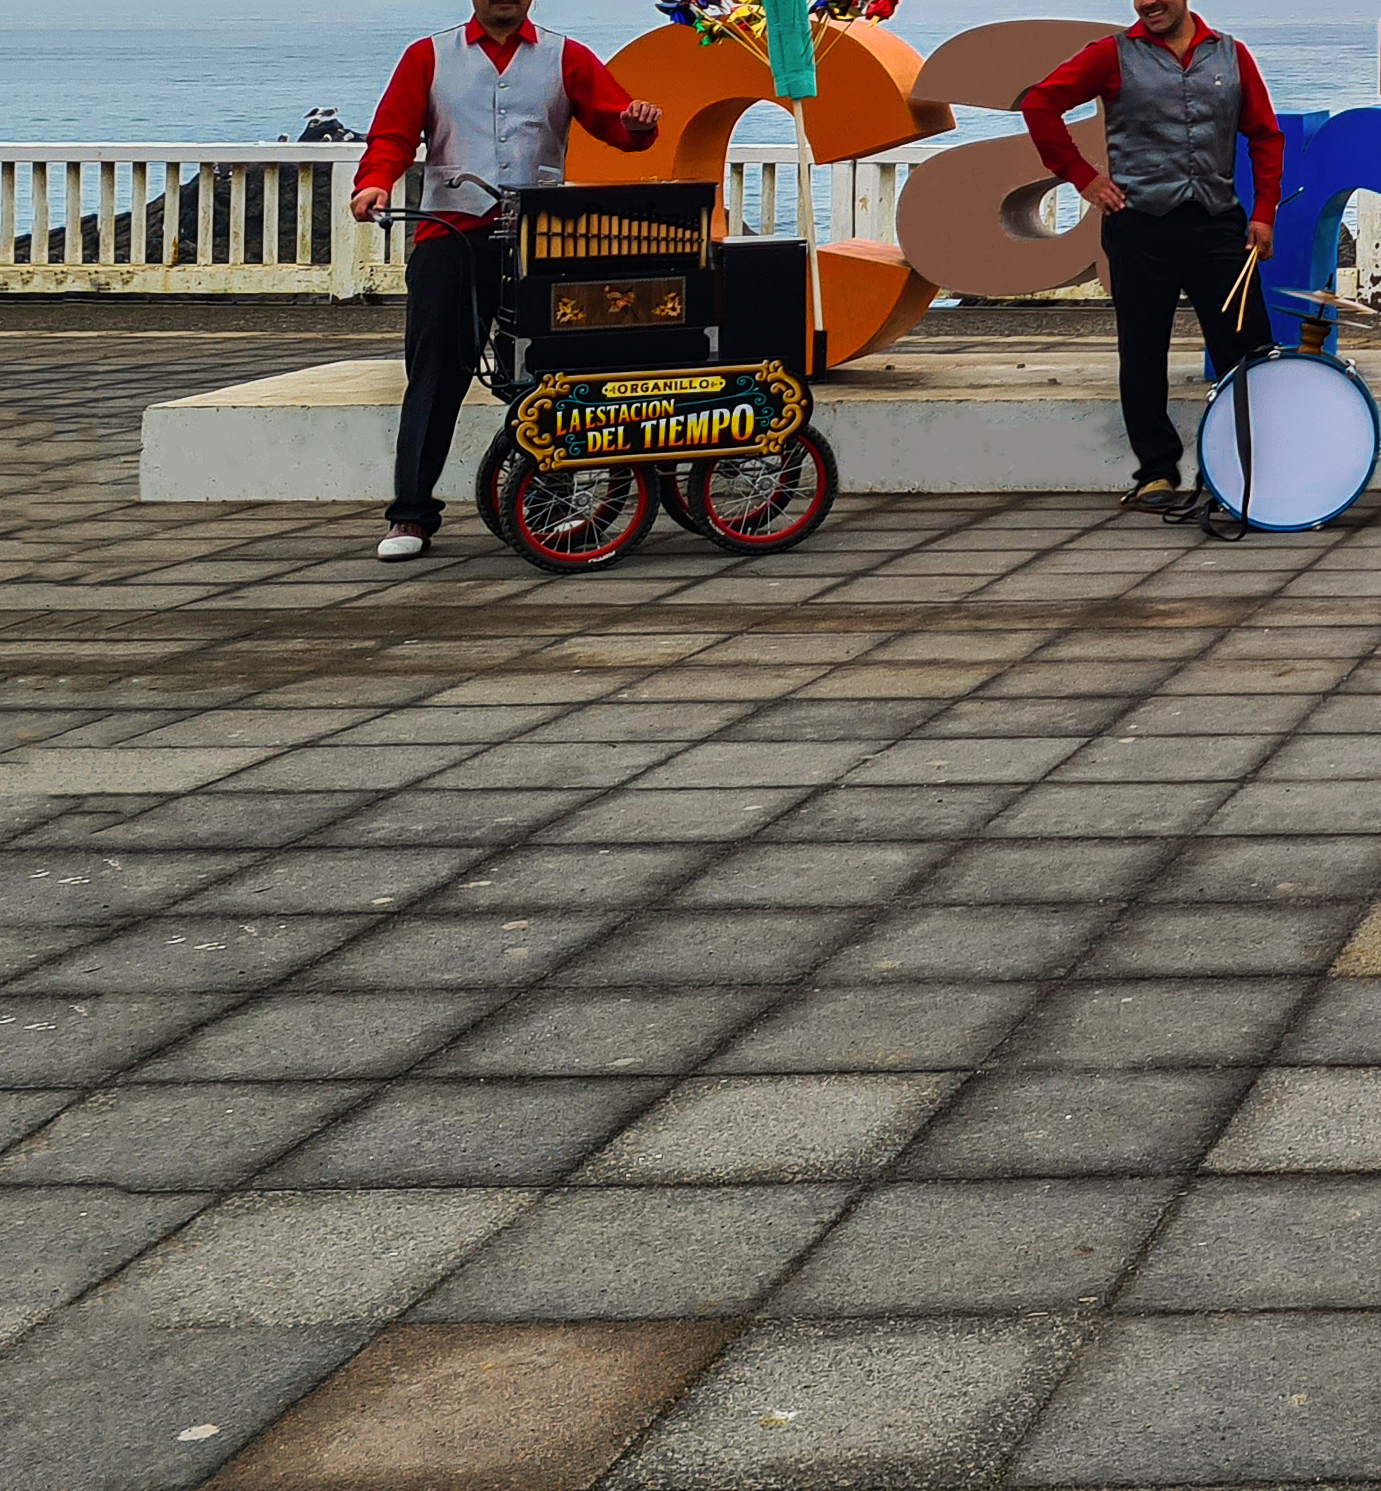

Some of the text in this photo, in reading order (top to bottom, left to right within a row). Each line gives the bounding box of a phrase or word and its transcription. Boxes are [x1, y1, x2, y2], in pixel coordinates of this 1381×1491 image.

[617, 379, 709, 395] ORGANILLO
[555, 399, 675, 436] LA ESTACION
[587, 403, 755, 453] DEL TIEMPO
